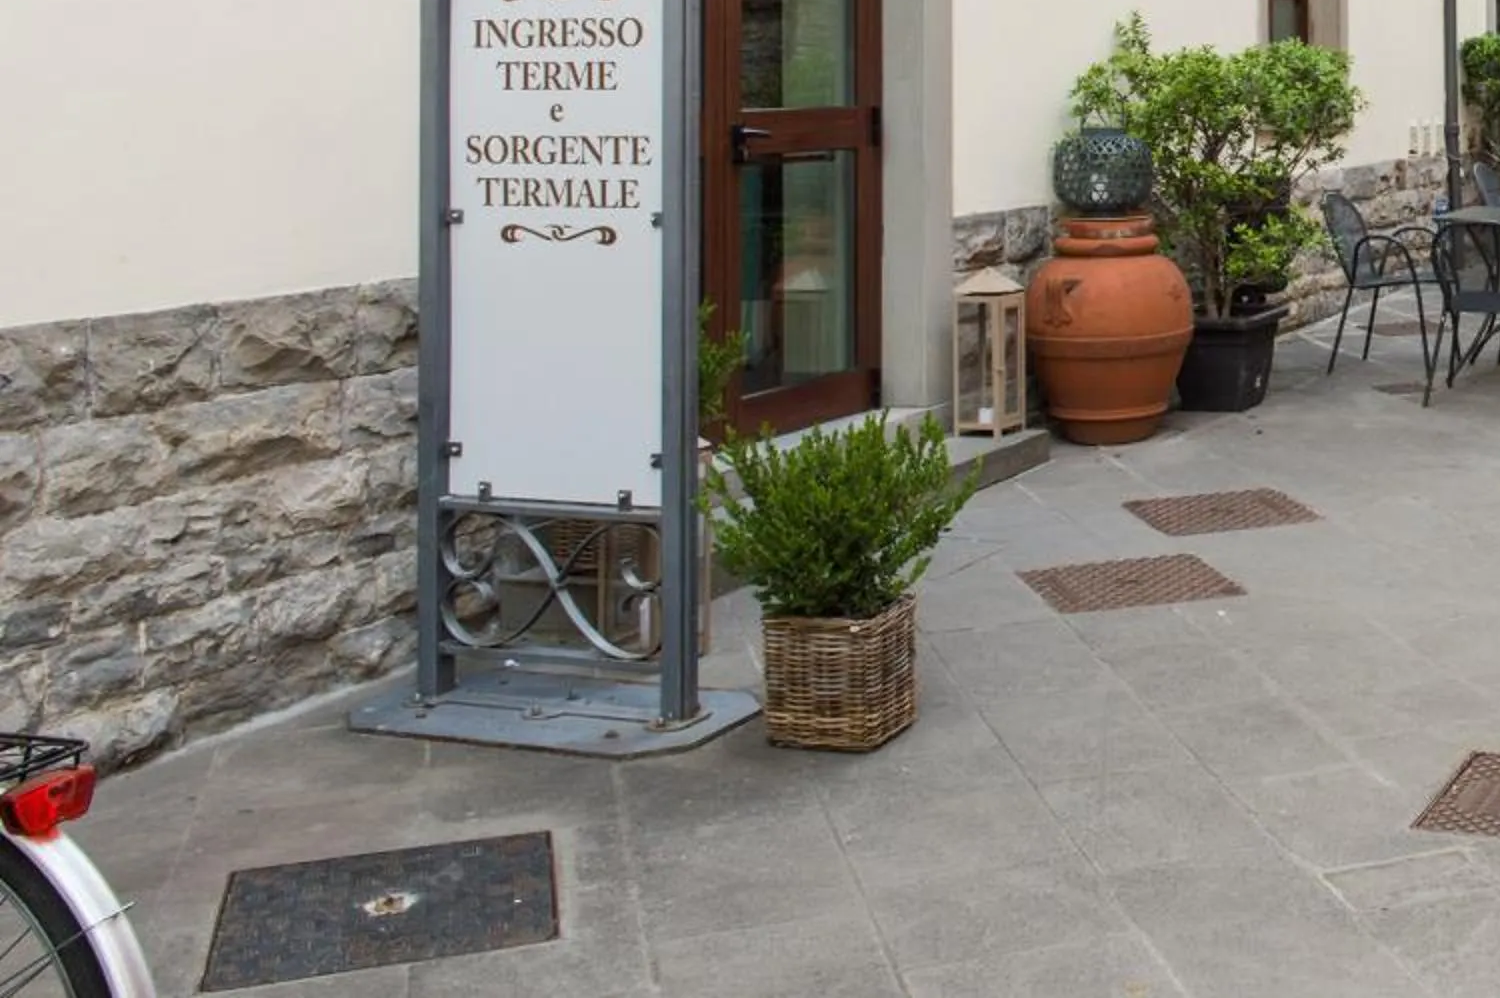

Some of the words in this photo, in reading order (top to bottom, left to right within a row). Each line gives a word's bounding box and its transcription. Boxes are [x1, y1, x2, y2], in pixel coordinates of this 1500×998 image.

[474, 17, 643, 49] INGRESSO
[496, 61, 617, 91] TERME
[549, 102, 564, 122] e
[466, 134, 652, 166] SORGENTE
[476, 176, 641, 209] TERMALE
